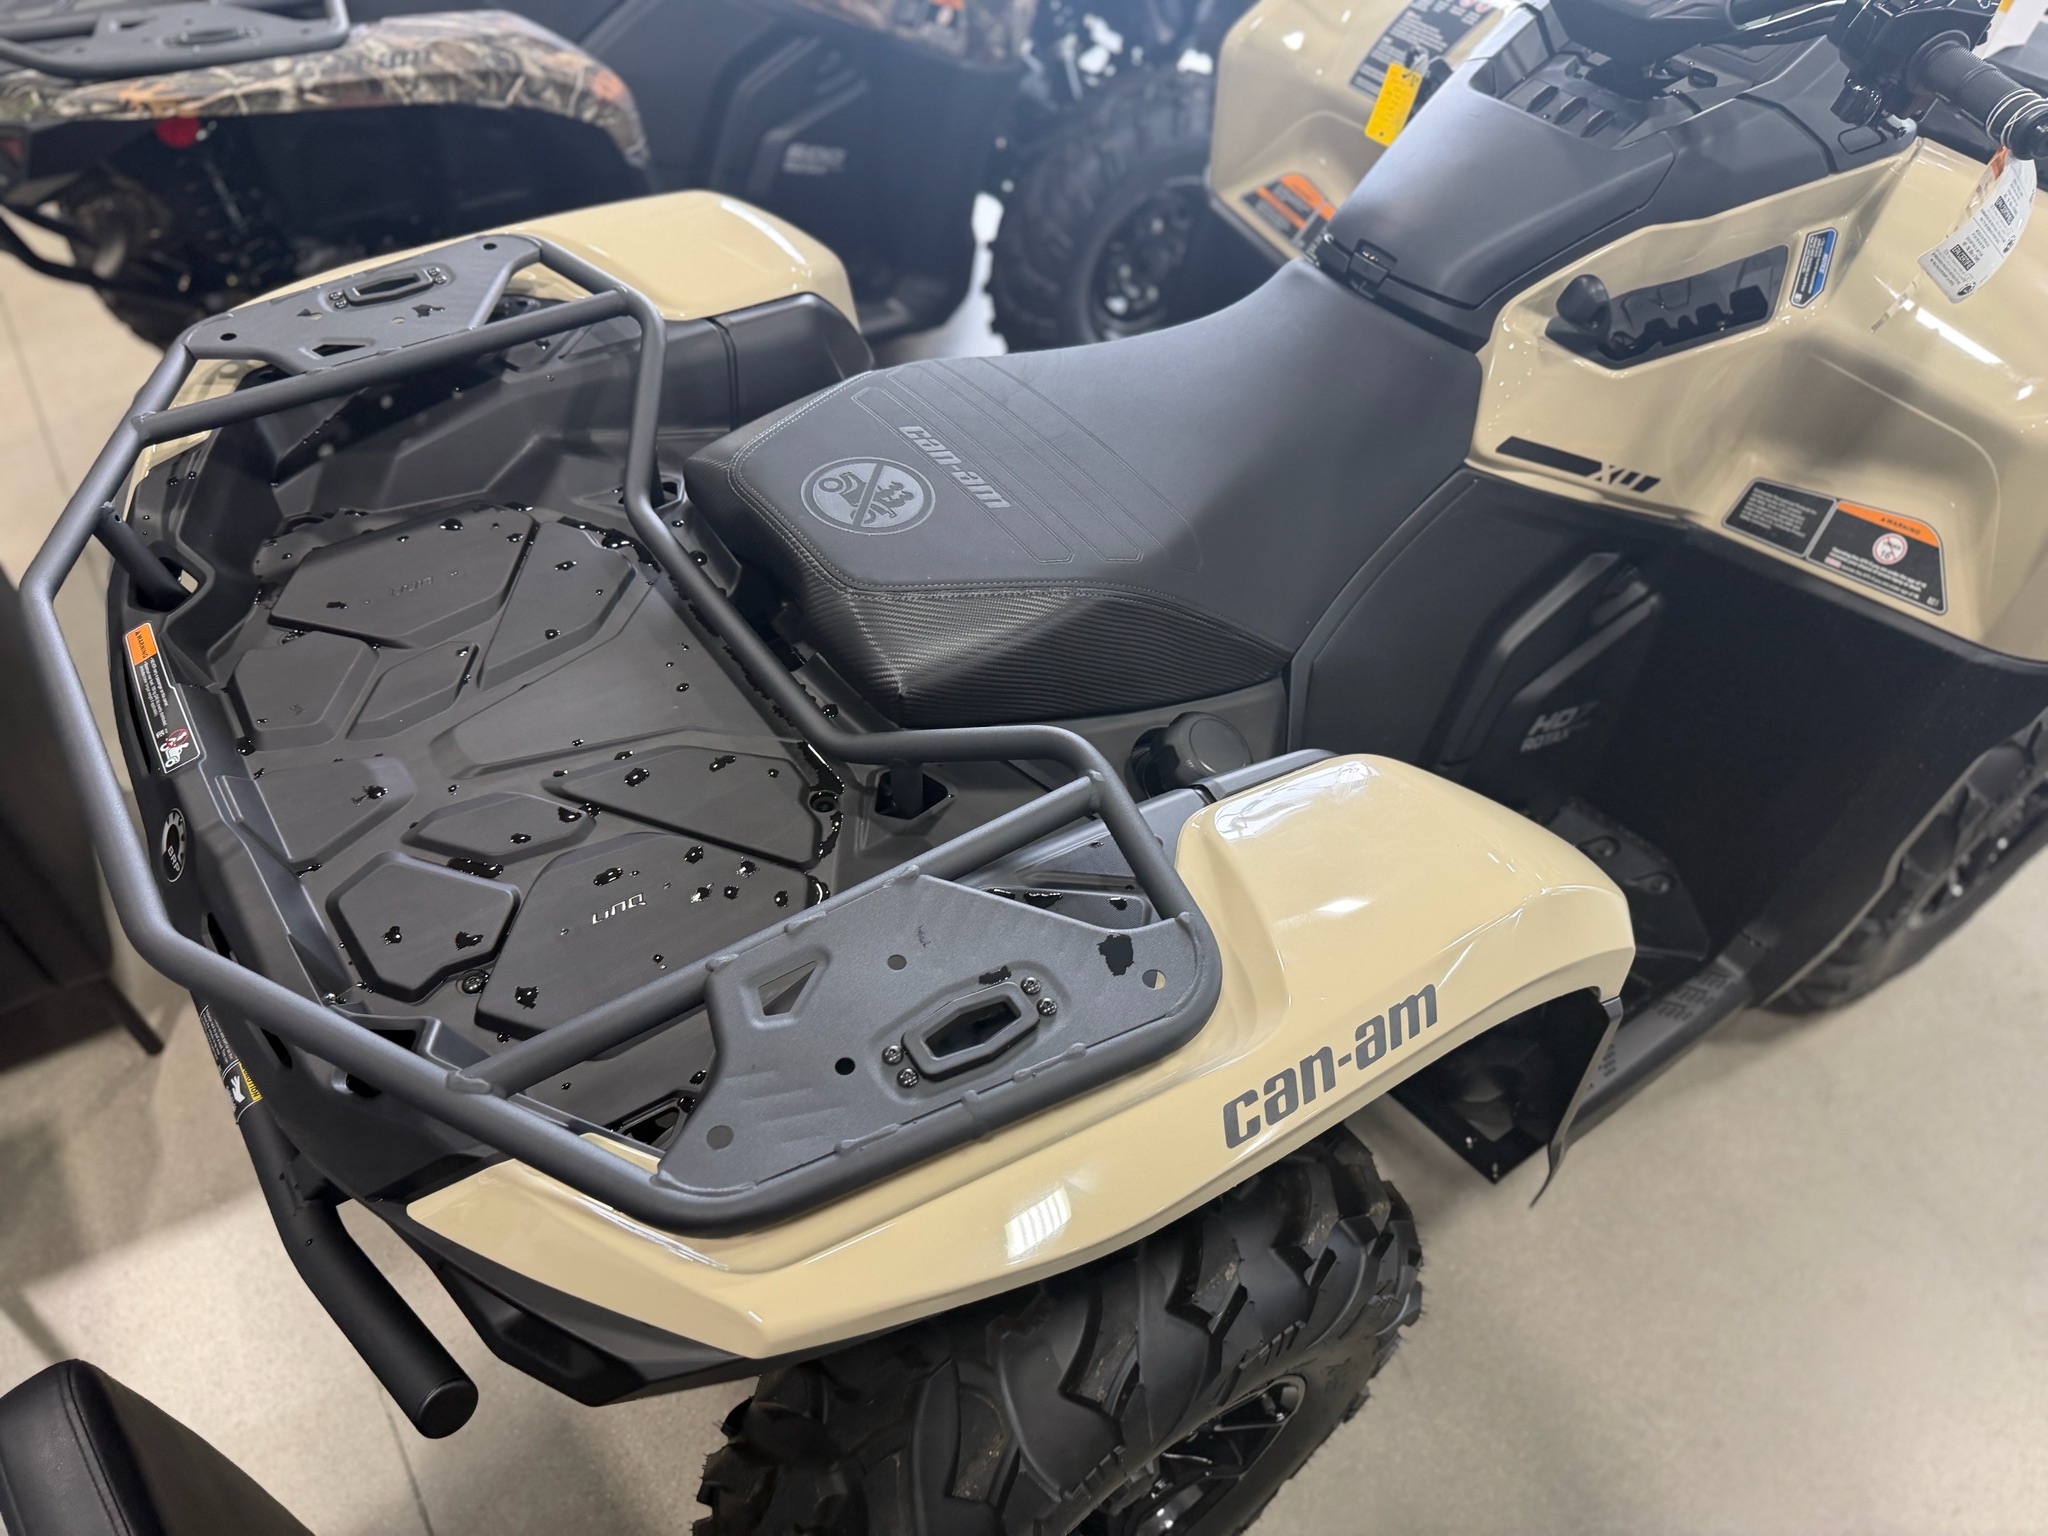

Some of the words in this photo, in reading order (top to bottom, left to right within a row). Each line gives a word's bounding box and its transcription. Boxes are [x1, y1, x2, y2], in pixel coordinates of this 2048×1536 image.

[899, 426, 1012, 509] can-am
[1887, 518, 1921, 535] WARNING
[136, 635, 149, 659] WARNING
[167, 845, 180, 872] BRP
[1222, 983, 1438, 1150] can-am
